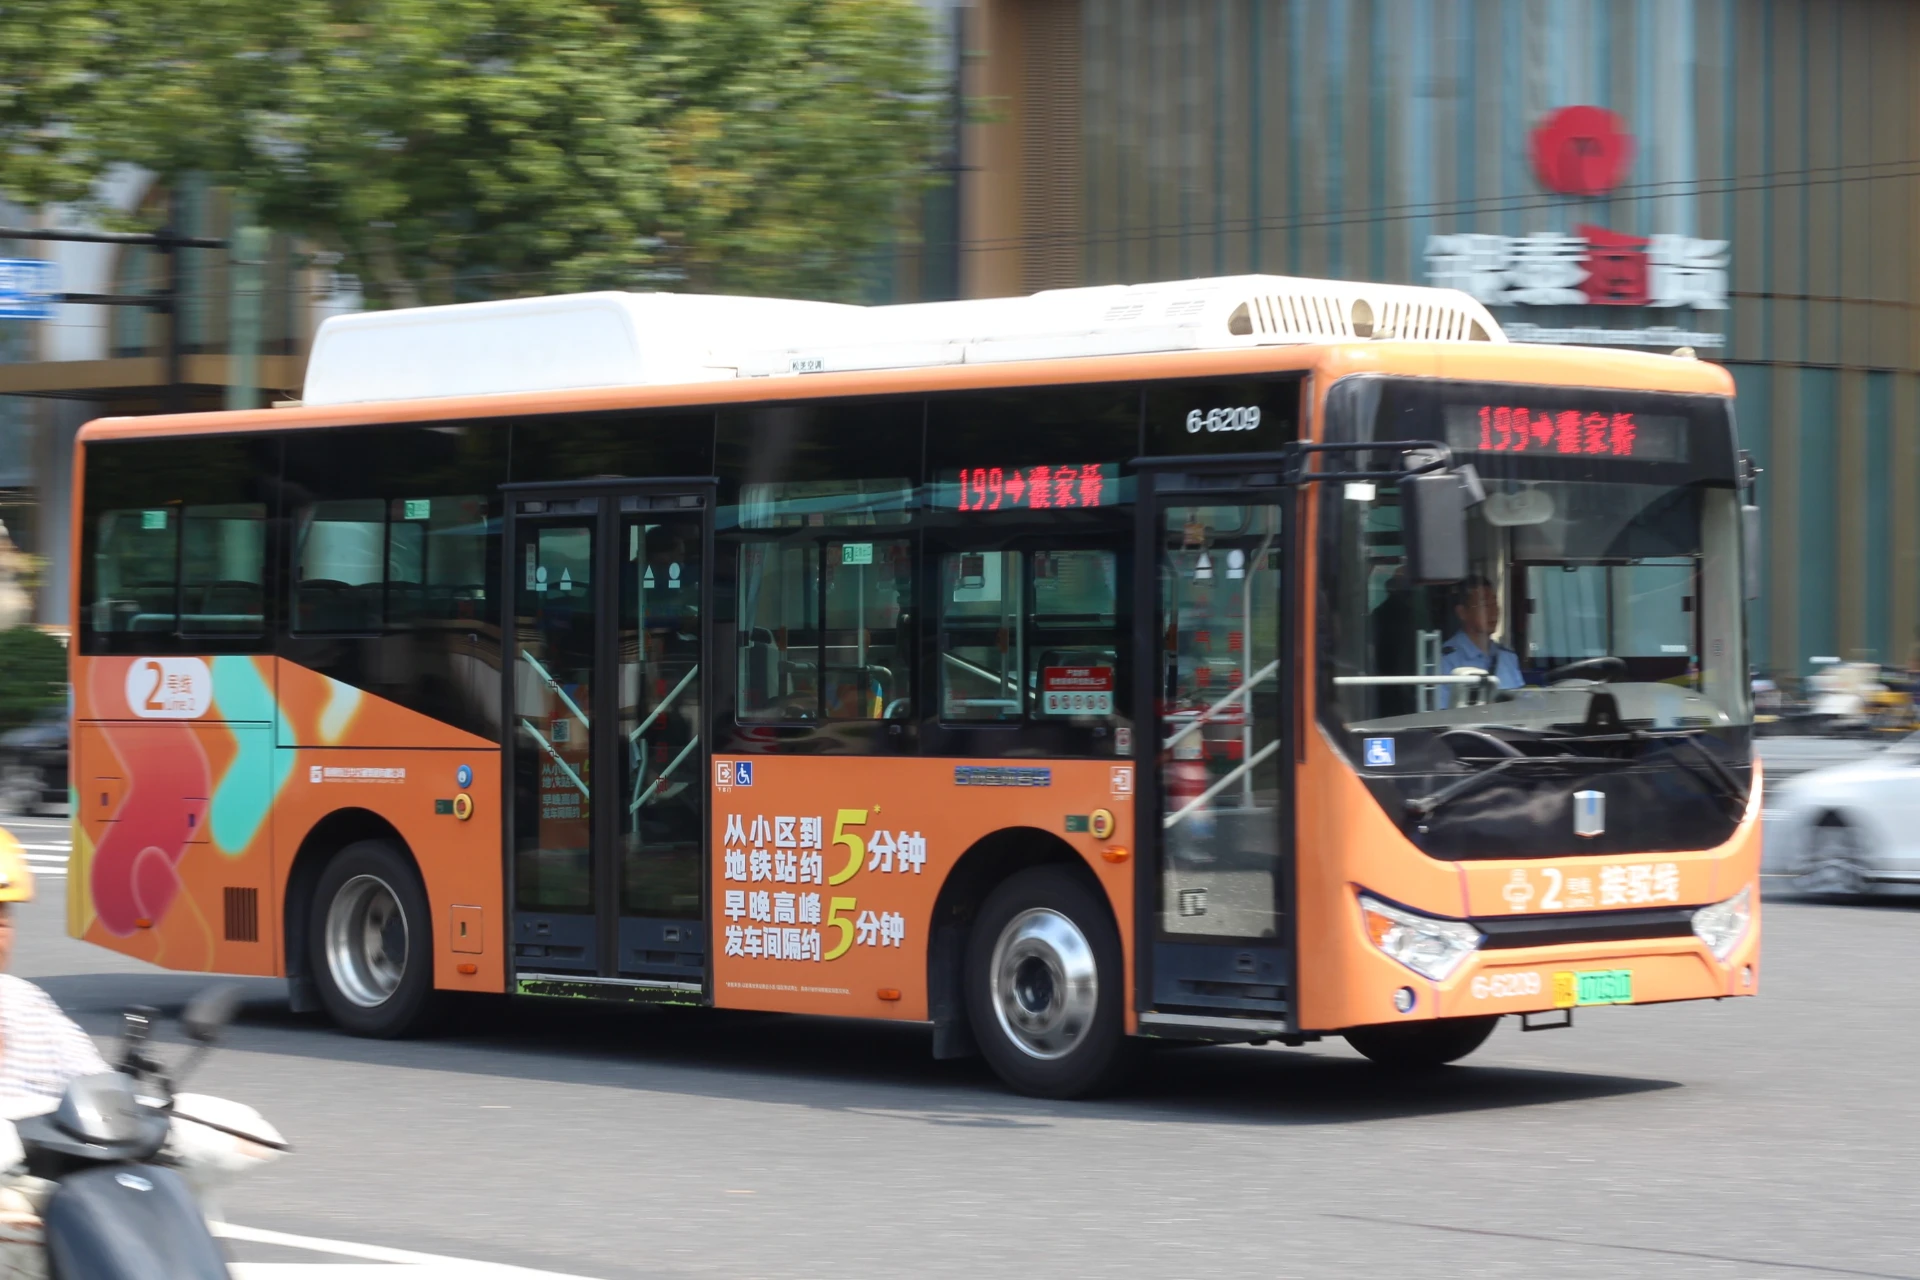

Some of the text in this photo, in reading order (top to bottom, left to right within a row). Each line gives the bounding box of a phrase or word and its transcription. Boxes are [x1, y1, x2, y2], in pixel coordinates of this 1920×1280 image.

[1187, 406, 1261, 433] 6-6209
[1478, 405, 1530, 452] 199
[958, 467, 1002, 511] 199
[145, 661, 164, 710] 2
[724, 814, 822, 850] 从小区到
[828, 808, 868, 886] 5
[868, 830, 926, 873] 分钟
[724, 849, 822, 885] 地铁站约
[724, 890, 821, 925] 早晚高峰
[1541, 868, 1562, 909] 2
[724, 925, 821, 962] 发车间隔约
[824, 896, 857, 961] 5
[856, 910, 904, 947] 分钟
[1470, 971, 1541, 999] 6-6209
